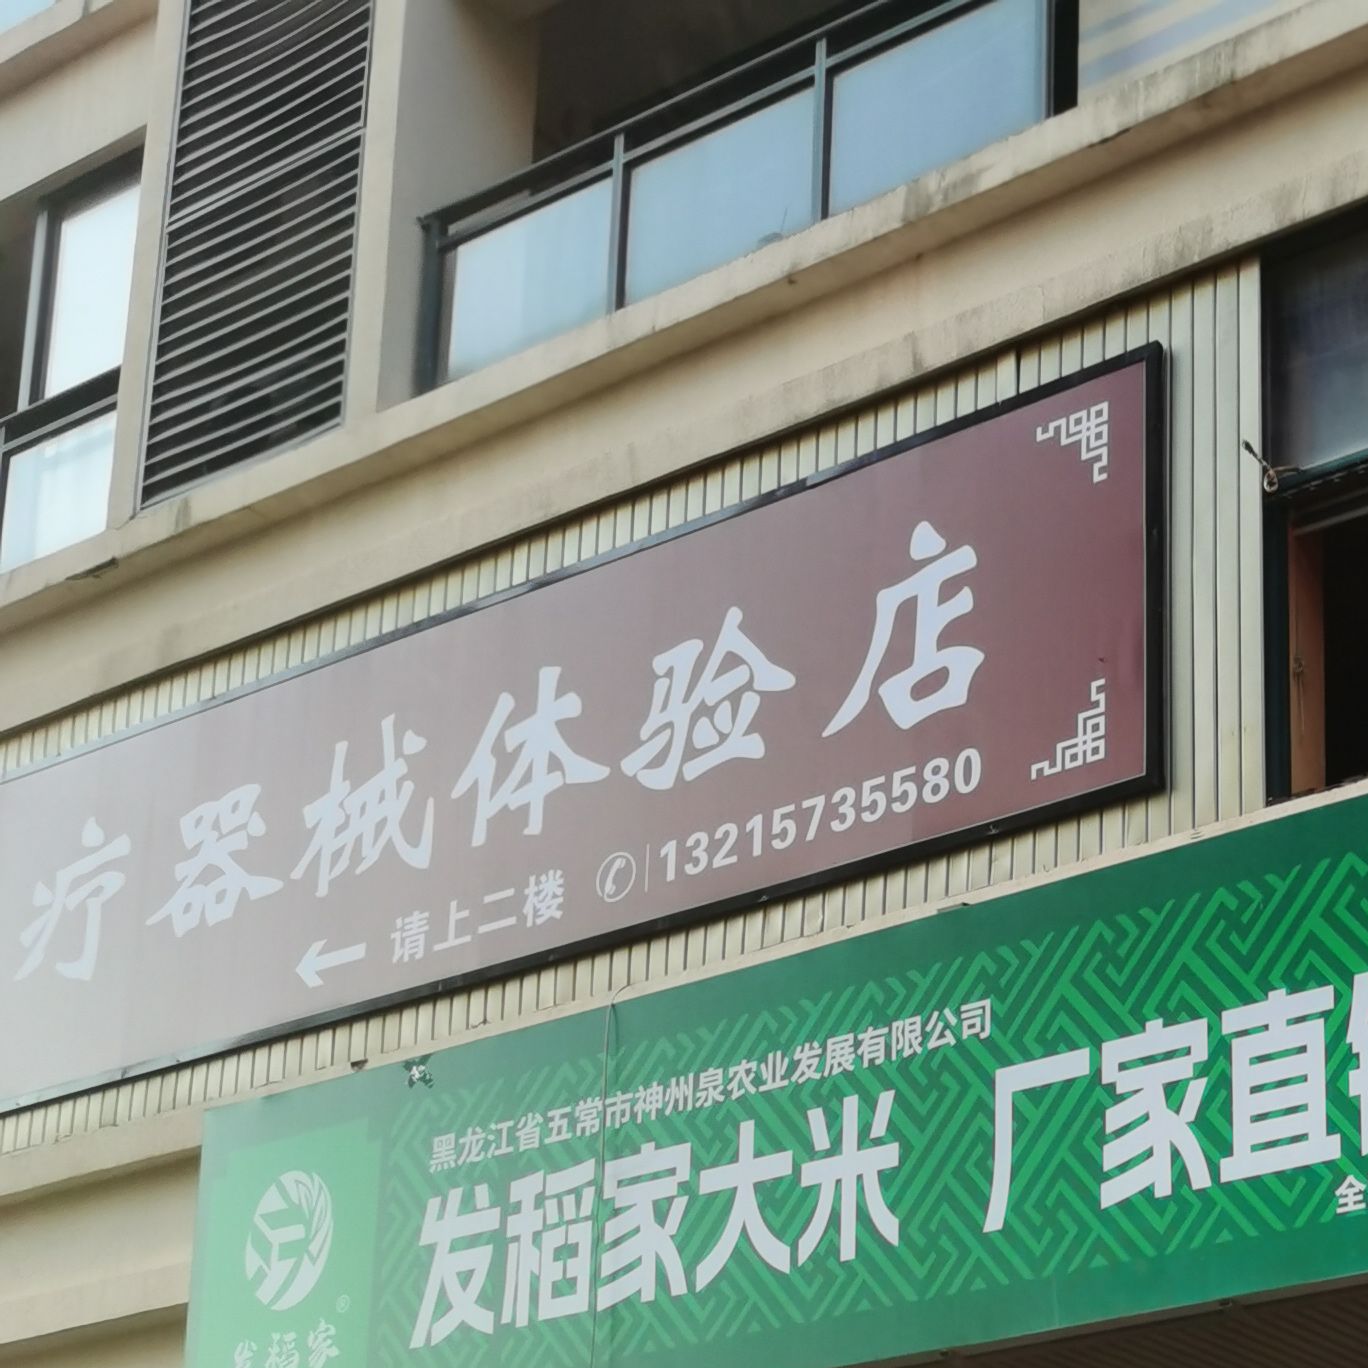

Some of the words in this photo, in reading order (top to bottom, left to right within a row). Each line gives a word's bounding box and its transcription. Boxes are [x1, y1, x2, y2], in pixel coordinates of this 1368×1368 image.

[16, 520, 986, 982] 疗器械体验店
[659, 747, 982, 882] 13215735580
[390, 869, 565, 963] 请上二楼
[429, 999, 992, 1174] 黑龙江省五常市神州泉农业发展有限公司
[409, 1090, 900, 1349] 发稻家大米
